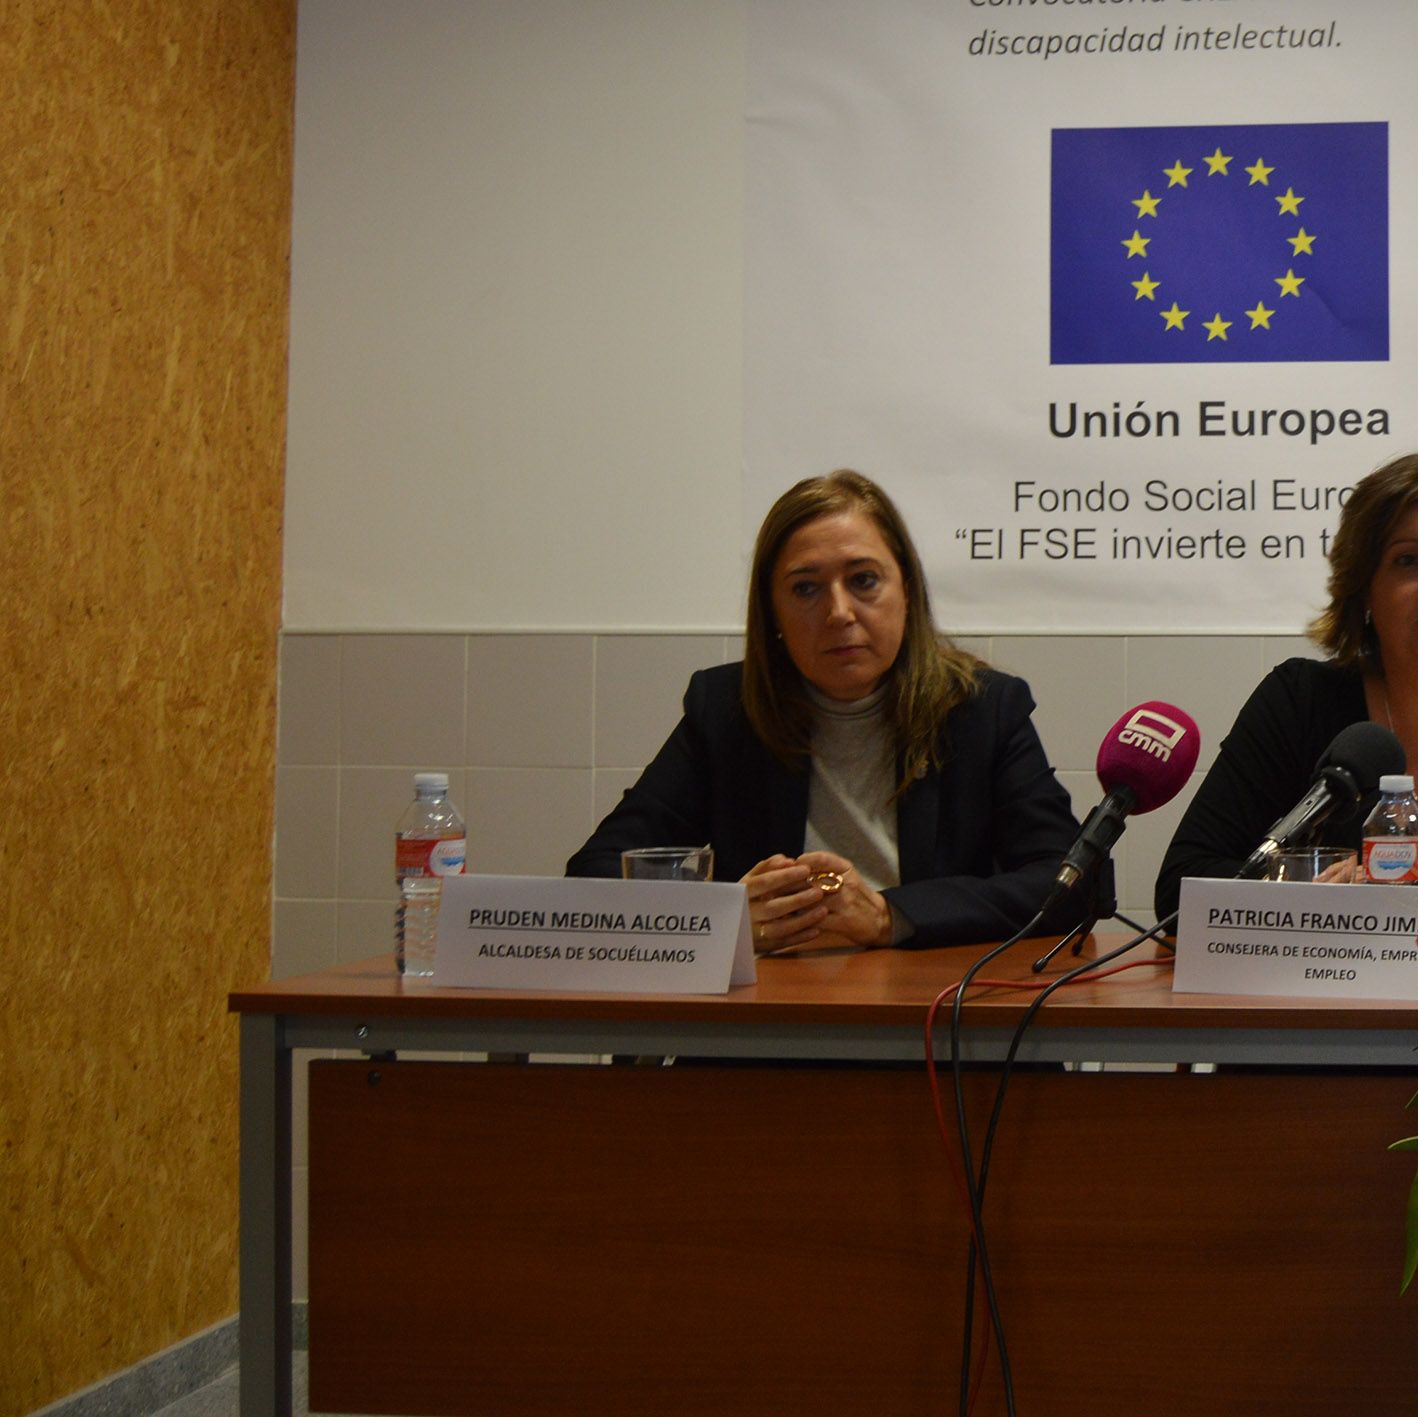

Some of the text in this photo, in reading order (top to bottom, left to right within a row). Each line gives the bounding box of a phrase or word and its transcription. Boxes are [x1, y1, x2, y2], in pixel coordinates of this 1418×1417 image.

[968, 20, 1341, 61] discapacidad intelectual.
[1049, 400, 1390, 446] Unión Europea
[1014, 477, 1351, 513] Fondo Social Euro
[955, 526, 1331, 560] “El FSE invierte en t
[468, 908, 711, 933] PRUDEN MEDINA ALCOLEA
[1208, 907, 1295, 929] PATRICIA
[1300, 910, 1378, 932] FRANCO
[478, 943, 695, 963] ALCALDESA DE SOCUÉLLAMOS
[1207, 941, 1279, 957] CONSEJERA
[1282, 945, 1300, 958] DE
[1302, 945, 1377, 962] ECONOMÍA,
[1304, 967, 1357, 981] EMPLEO
